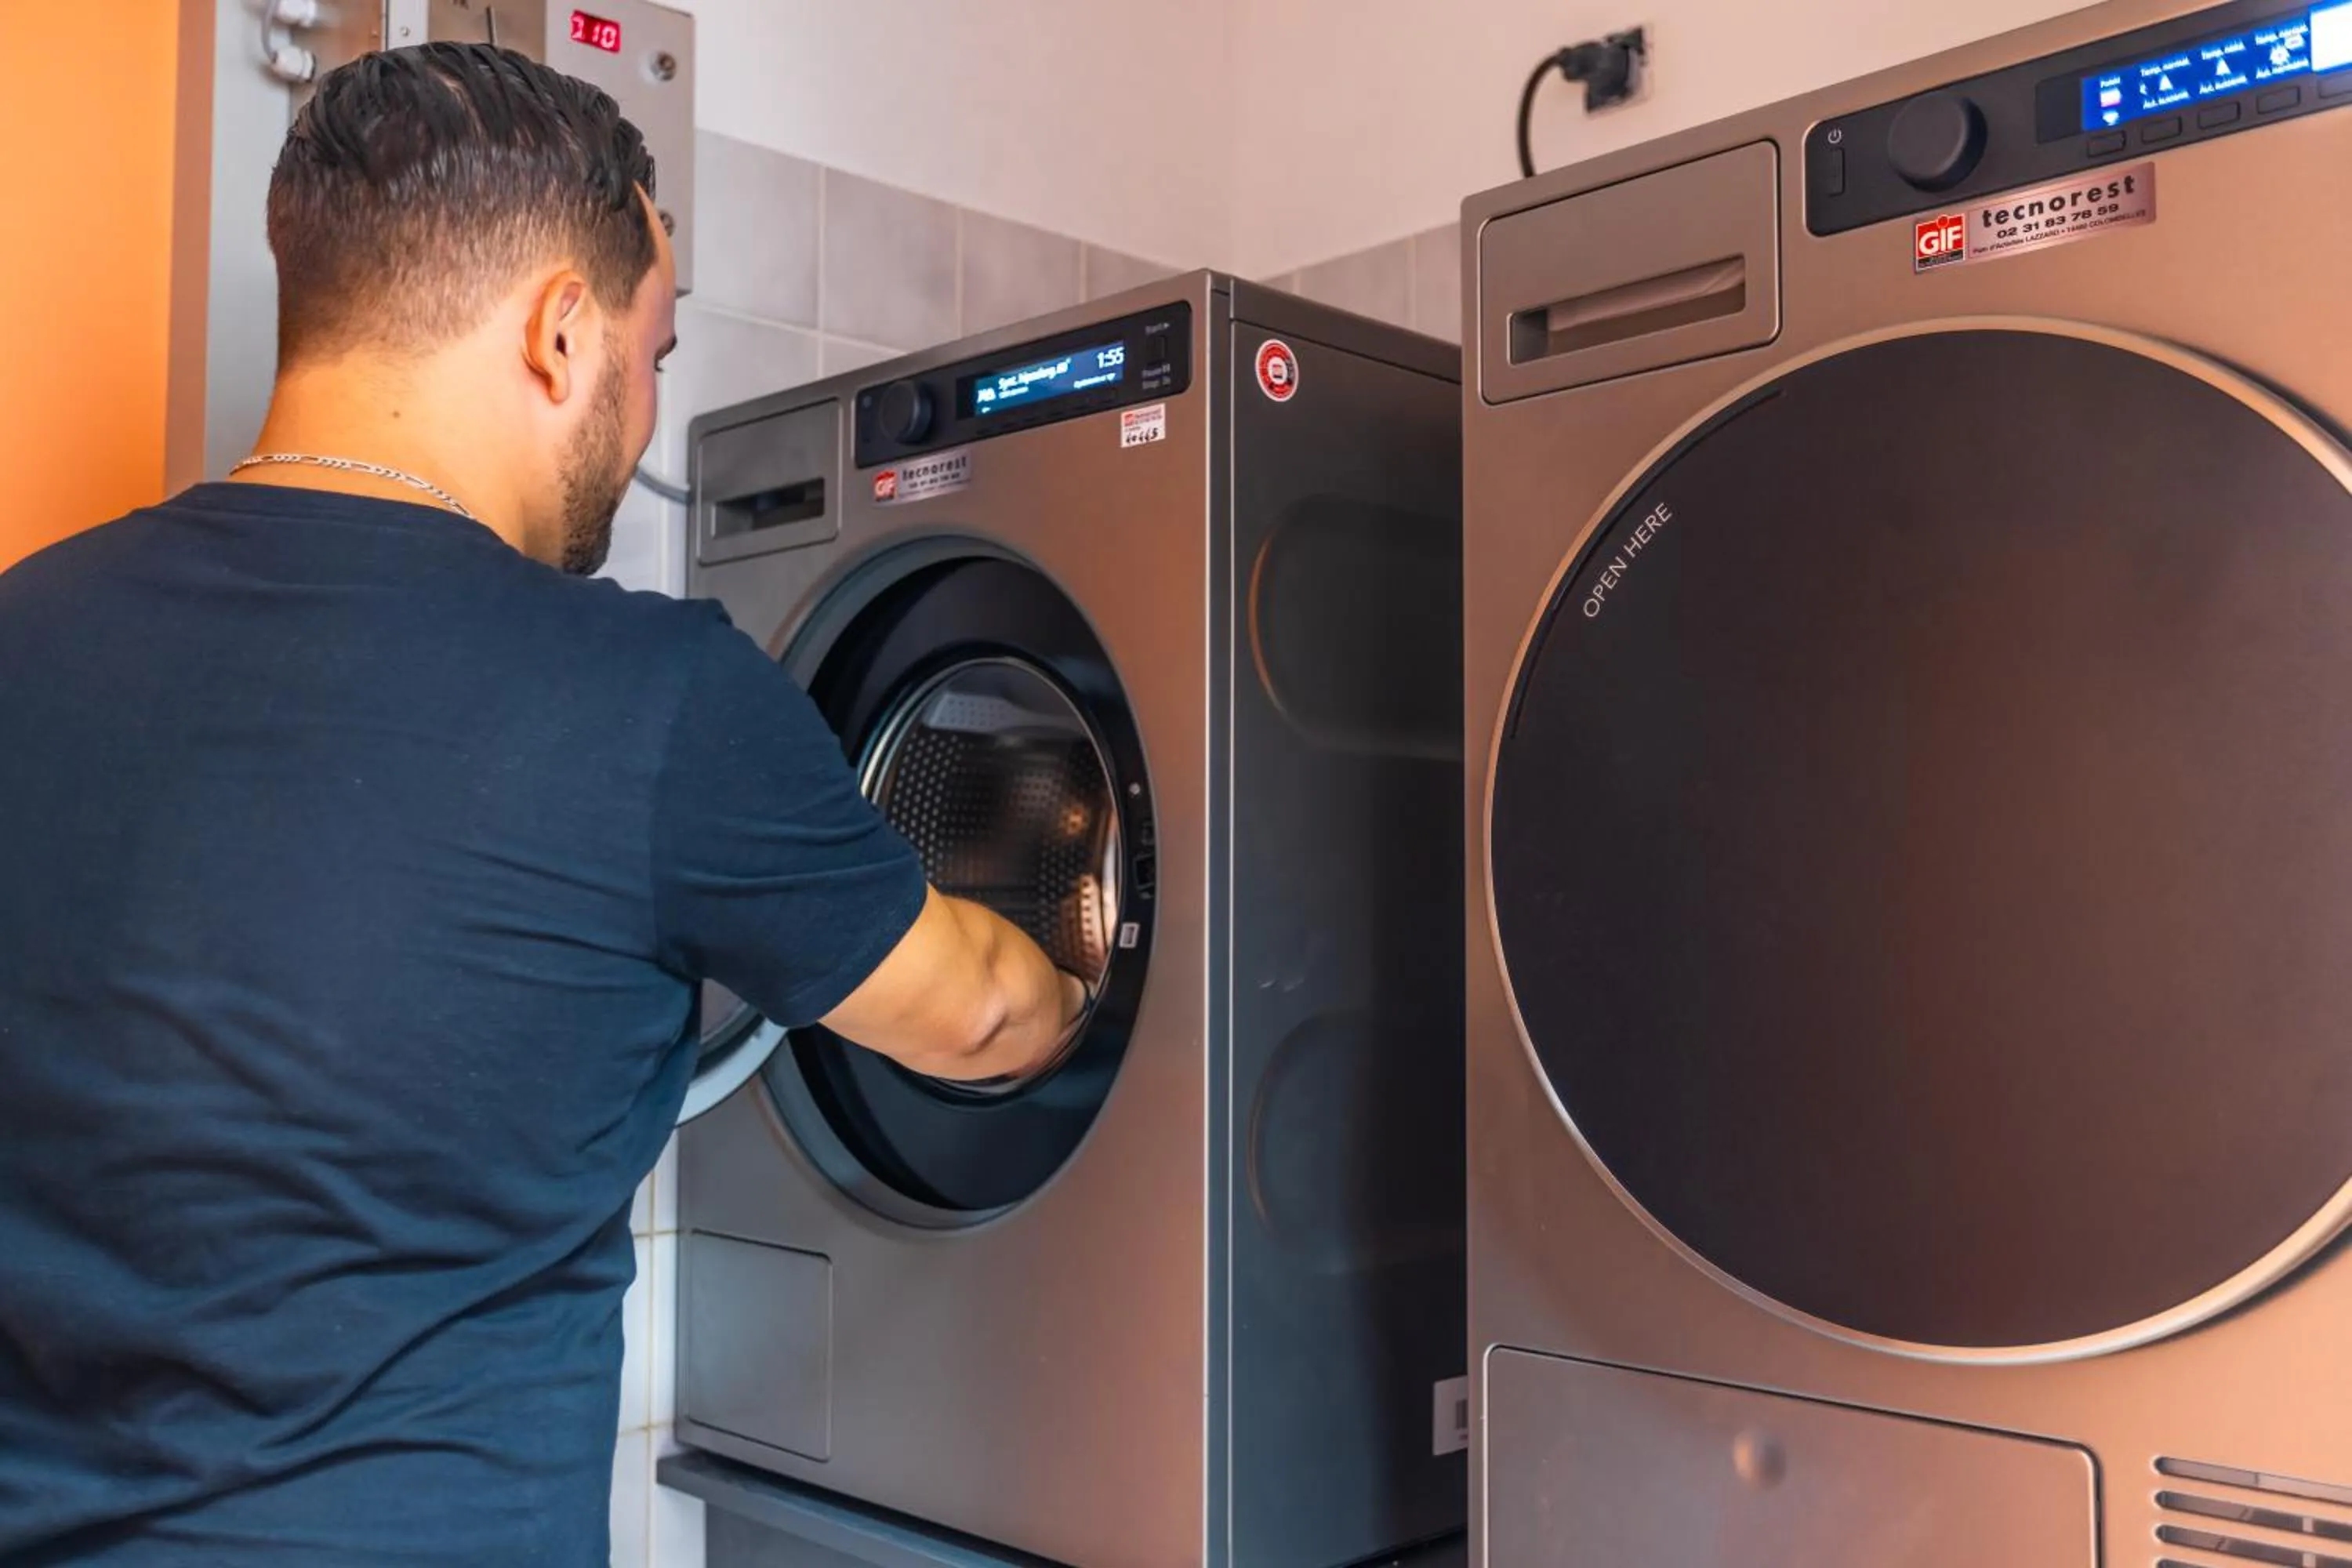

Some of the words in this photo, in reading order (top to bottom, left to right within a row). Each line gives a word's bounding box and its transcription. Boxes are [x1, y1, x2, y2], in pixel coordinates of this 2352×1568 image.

[1982, 175, 2136, 228] tecnorest
[1918, 216, 1962, 256] GIF
[1997, 227, 2018, 239] 02
[2023, 223, 2039, 233] 31
[2045, 216, 2066, 228] 83
[2071, 209, 2092, 222] 78
[2097, 203, 2119, 216] 59
[1097, 347, 1124, 368] 1:55
[902, 456, 967, 481] tecnorest
[1583, 556, 1628, 617] OPEN
[1624, 502, 1673, 558] HERE
